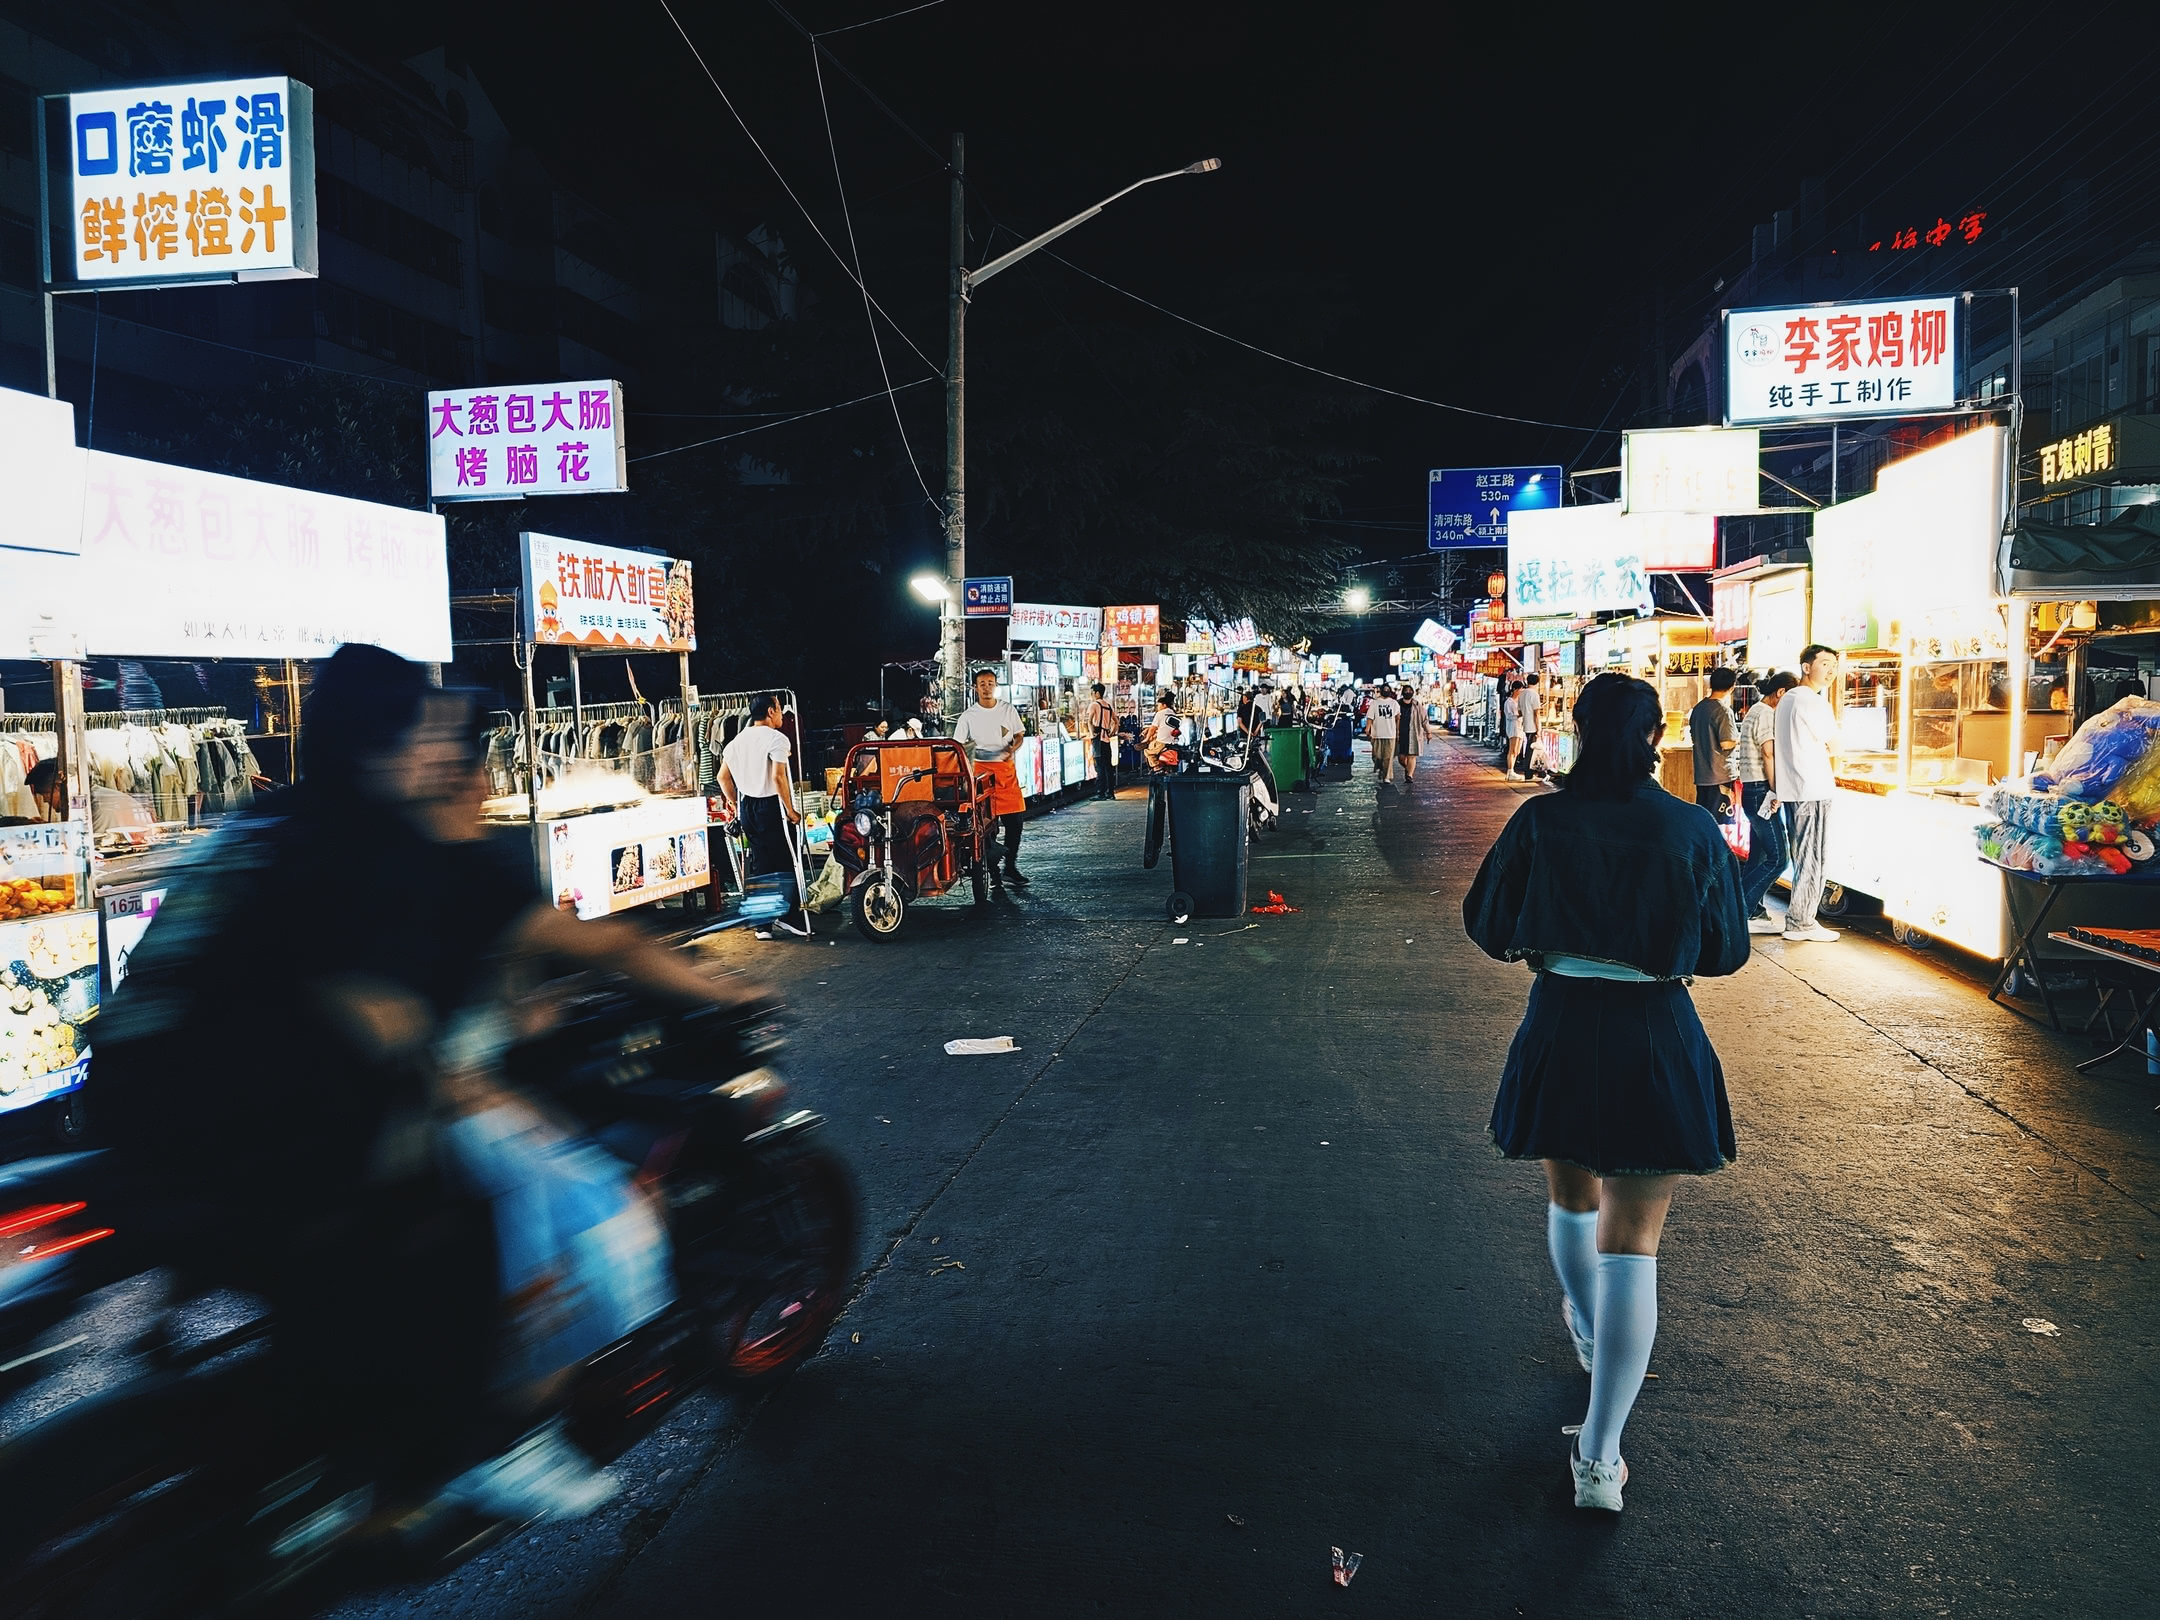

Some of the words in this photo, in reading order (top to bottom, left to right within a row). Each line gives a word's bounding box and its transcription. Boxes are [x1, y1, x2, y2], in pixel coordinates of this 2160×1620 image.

[76, 92, 284, 177] 口蘑虾滑
[81, 184, 286, 263] 鲜榨橙汁
[1784, 310, 1946, 374] 李家鸡柳
[1769, 377, 1912, 408] 纯手工制作
[432, 390, 611, 439] 大葱包大肠
[455, 441, 590, 487] 烤脑花
[2040, 424, 2112, 485] 百鬼刺青
[1475, 473, 1515, 488] 赵王路
[1481, 491, 1510, 501] 530m
[1434, 513, 1473, 527] 清河东路
[1435, 530, 1464, 541] 340m
[557, 551, 667, 607] 铁板大鱿鱼
[980, 594, 1008, 604] 禁止占用
[1072, 612, 1098, 630] 西瓜汁
[110, 895, 143, 914] 16元
